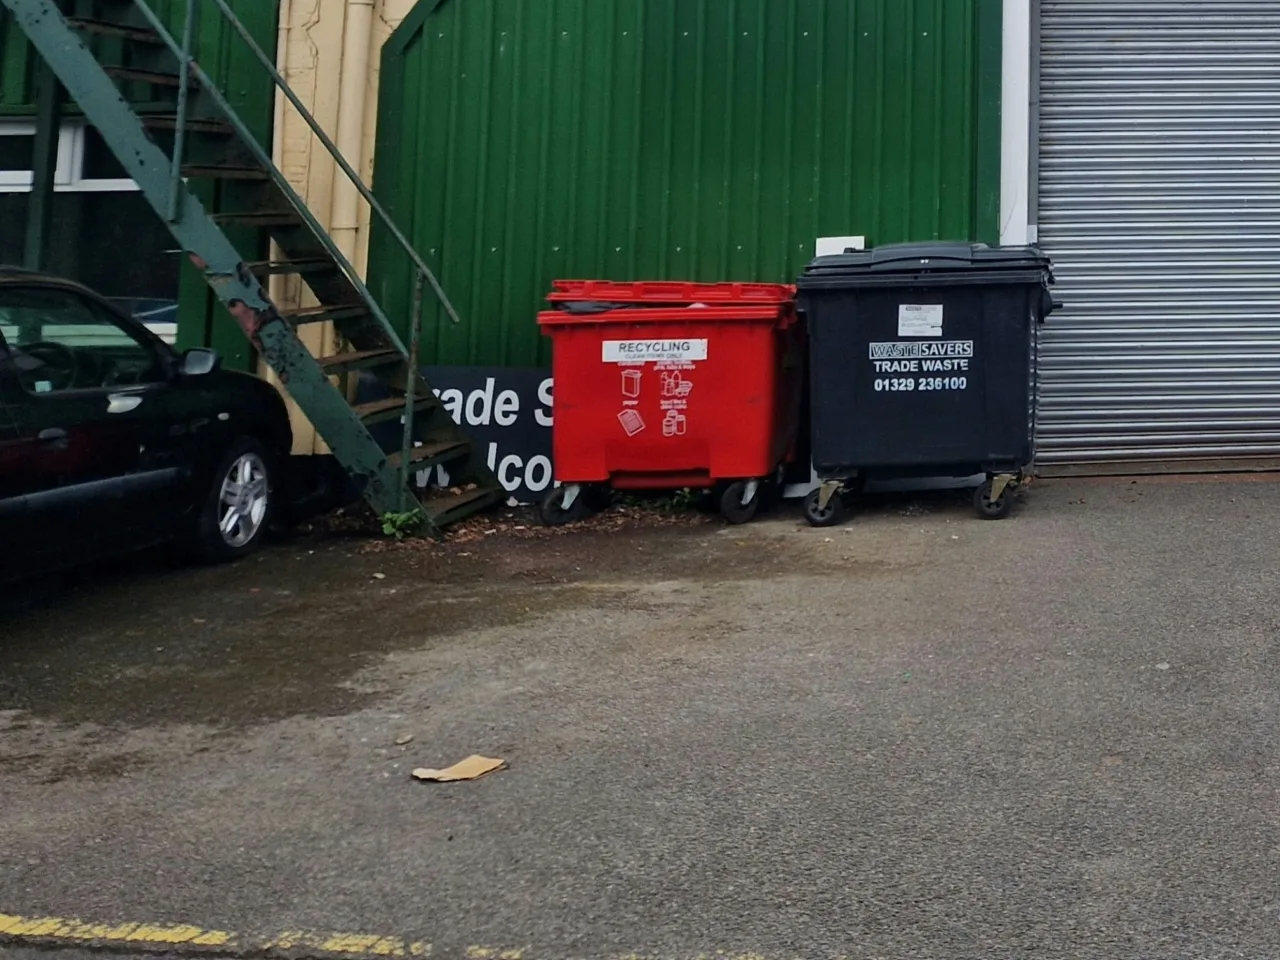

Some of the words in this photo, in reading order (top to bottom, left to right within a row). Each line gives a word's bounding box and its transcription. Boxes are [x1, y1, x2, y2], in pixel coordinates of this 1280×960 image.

[619, 342, 690, 352] RECYCLING
[872, 344, 918, 357] WASTE
[921, 343, 971, 355] SAVERS
[873, 361, 919, 373] TRADE
[921, 359, 969, 372] WASTE
[874, 378, 915, 392] 01329
[918, 376, 967, 391] 236100
[432, 377, 520, 426] ade
